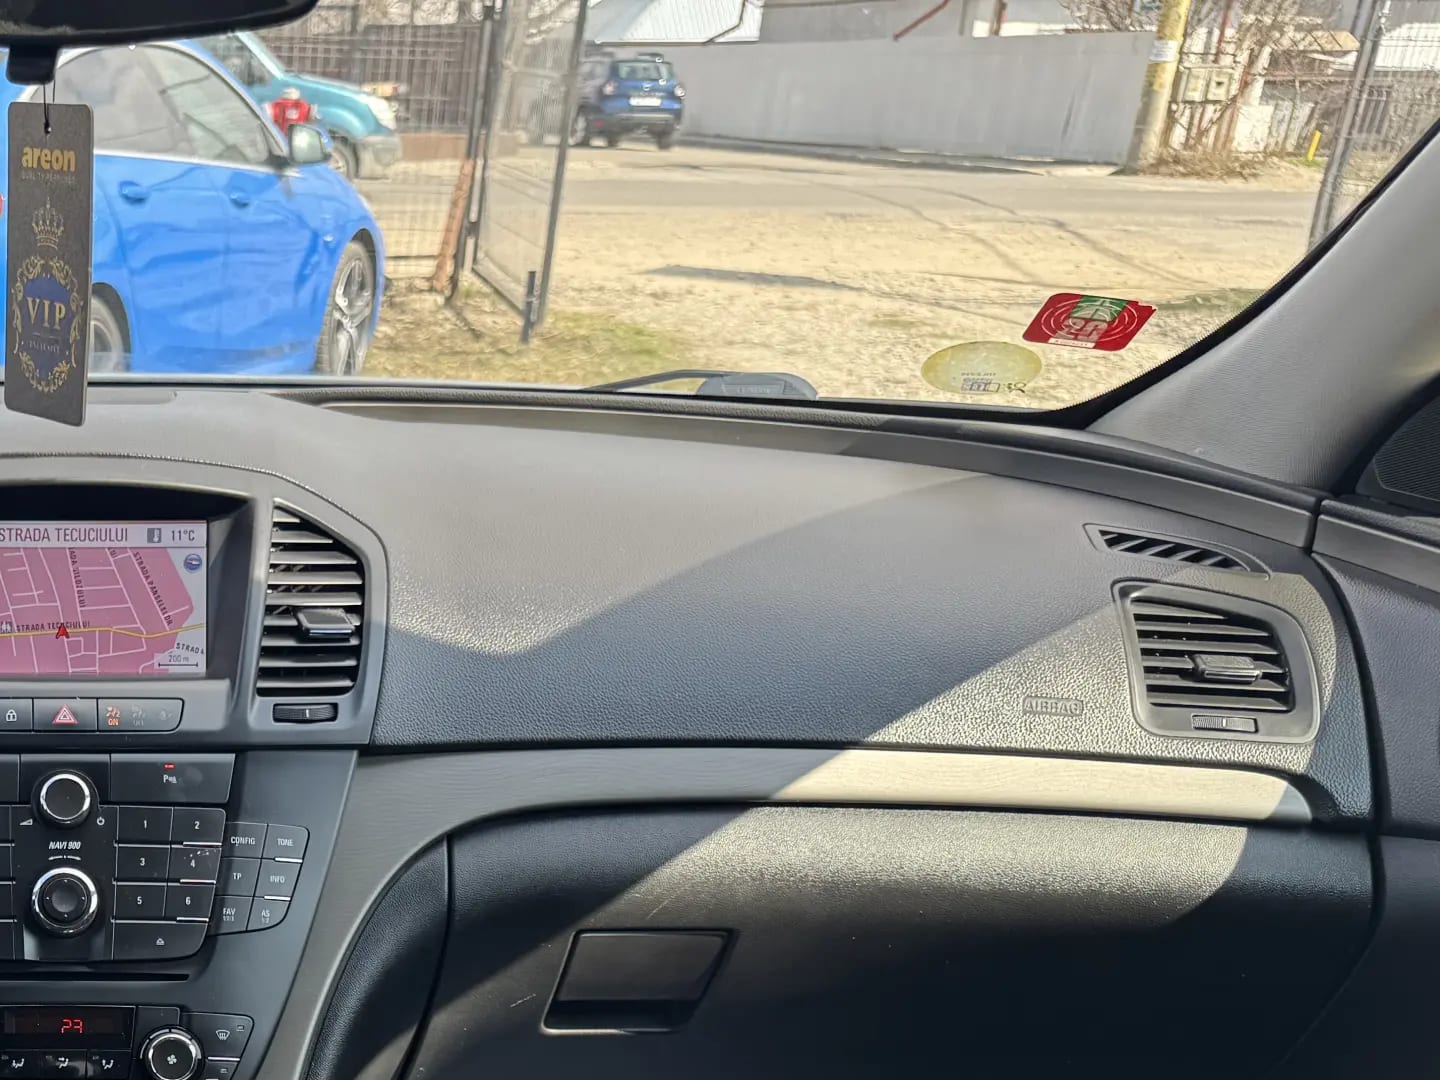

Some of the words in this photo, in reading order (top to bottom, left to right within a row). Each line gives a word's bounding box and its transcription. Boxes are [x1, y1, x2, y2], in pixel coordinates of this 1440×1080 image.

[22, 146, 76, 171] areon
[26, 296, 66, 330] VIP
[54, 527, 128, 542] TECUCIULUI
[171, 529, 196, 541] 11°C
[133, 551, 151, 579] STRADA
[16, 623, 45, 632] STRADA
[168, 655, 181, 663] 200
[1023, 698, 1083, 715] AIRBAG
[230, 836, 256, 845] CONFIG
[277, 838, 294, 846] TONE
[48, 841, 67, 850] NAVI
[67, 841, 81, 850] 900
[232, 872, 242, 880] TP
[269, 875, 285, 883] INFO
[222, 907, 236, 915] FAV
[261, 909, 270, 917] AS
